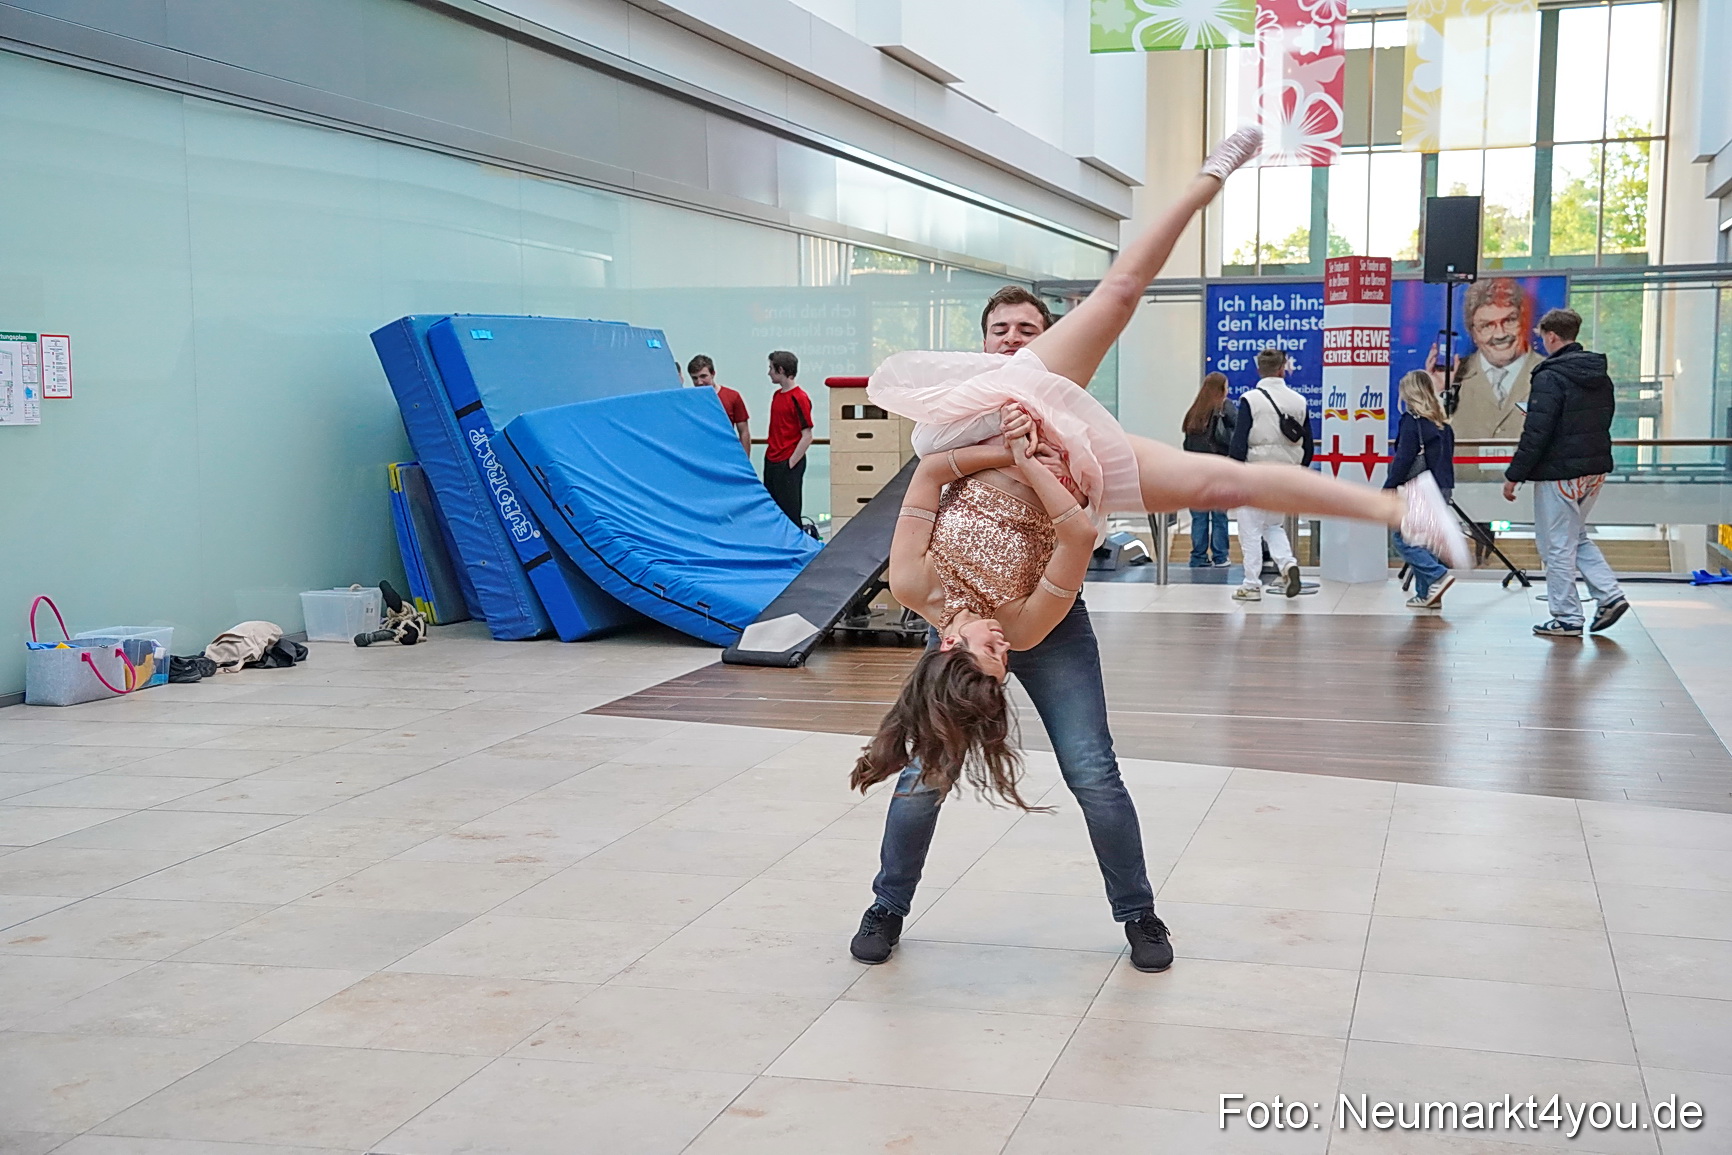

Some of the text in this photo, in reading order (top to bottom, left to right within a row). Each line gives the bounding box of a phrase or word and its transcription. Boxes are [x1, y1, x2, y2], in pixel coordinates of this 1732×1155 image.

[1219, 294, 1324, 312] Ich hab ihn:
[1218, 314, 1324, 331] den kleinste
[1218, 334, 1307, 351] Fernseher
[1324, 330, 1352, 348] REWE
[1353, 330, 1390, 348] REWE
[1218, 354, 1248, 371] der
[1323, 350, 1351, 363] CENTER
[1353, 349, 1389, 363] CENTER
[1328, 385, 1346, 408] dm
[1360, 385, 1383, 408] dm
[468, 429, 534, 542] EUROTRAMP
